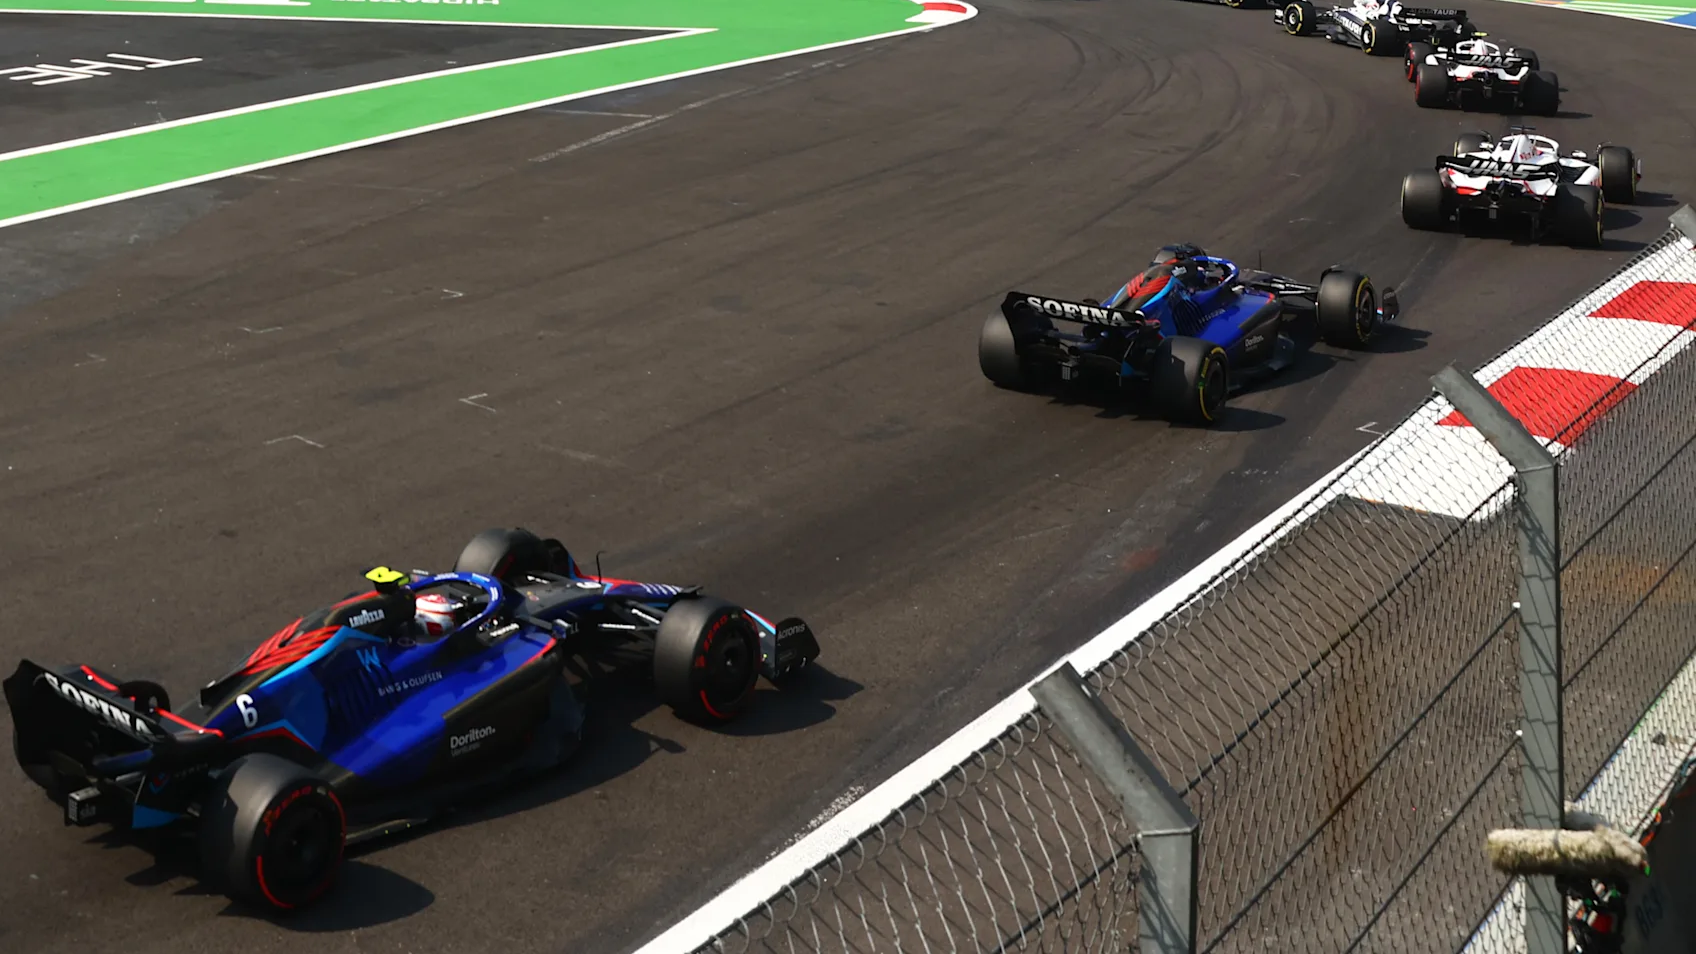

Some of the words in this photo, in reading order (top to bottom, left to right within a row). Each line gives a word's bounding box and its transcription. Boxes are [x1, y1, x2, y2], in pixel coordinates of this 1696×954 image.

[1468, 54, 1522, 68] HAAS
[1464, 159, 1542, 179] HAAS
[1027, 296, 1130, 327] SOFINA
[348, 608, 385, 629] LAVAZZA
[777, 624, 806, 641] Acronis
[409, 671, 443, 687] OLUFSEN
[236, 693, 258, 728] 6
